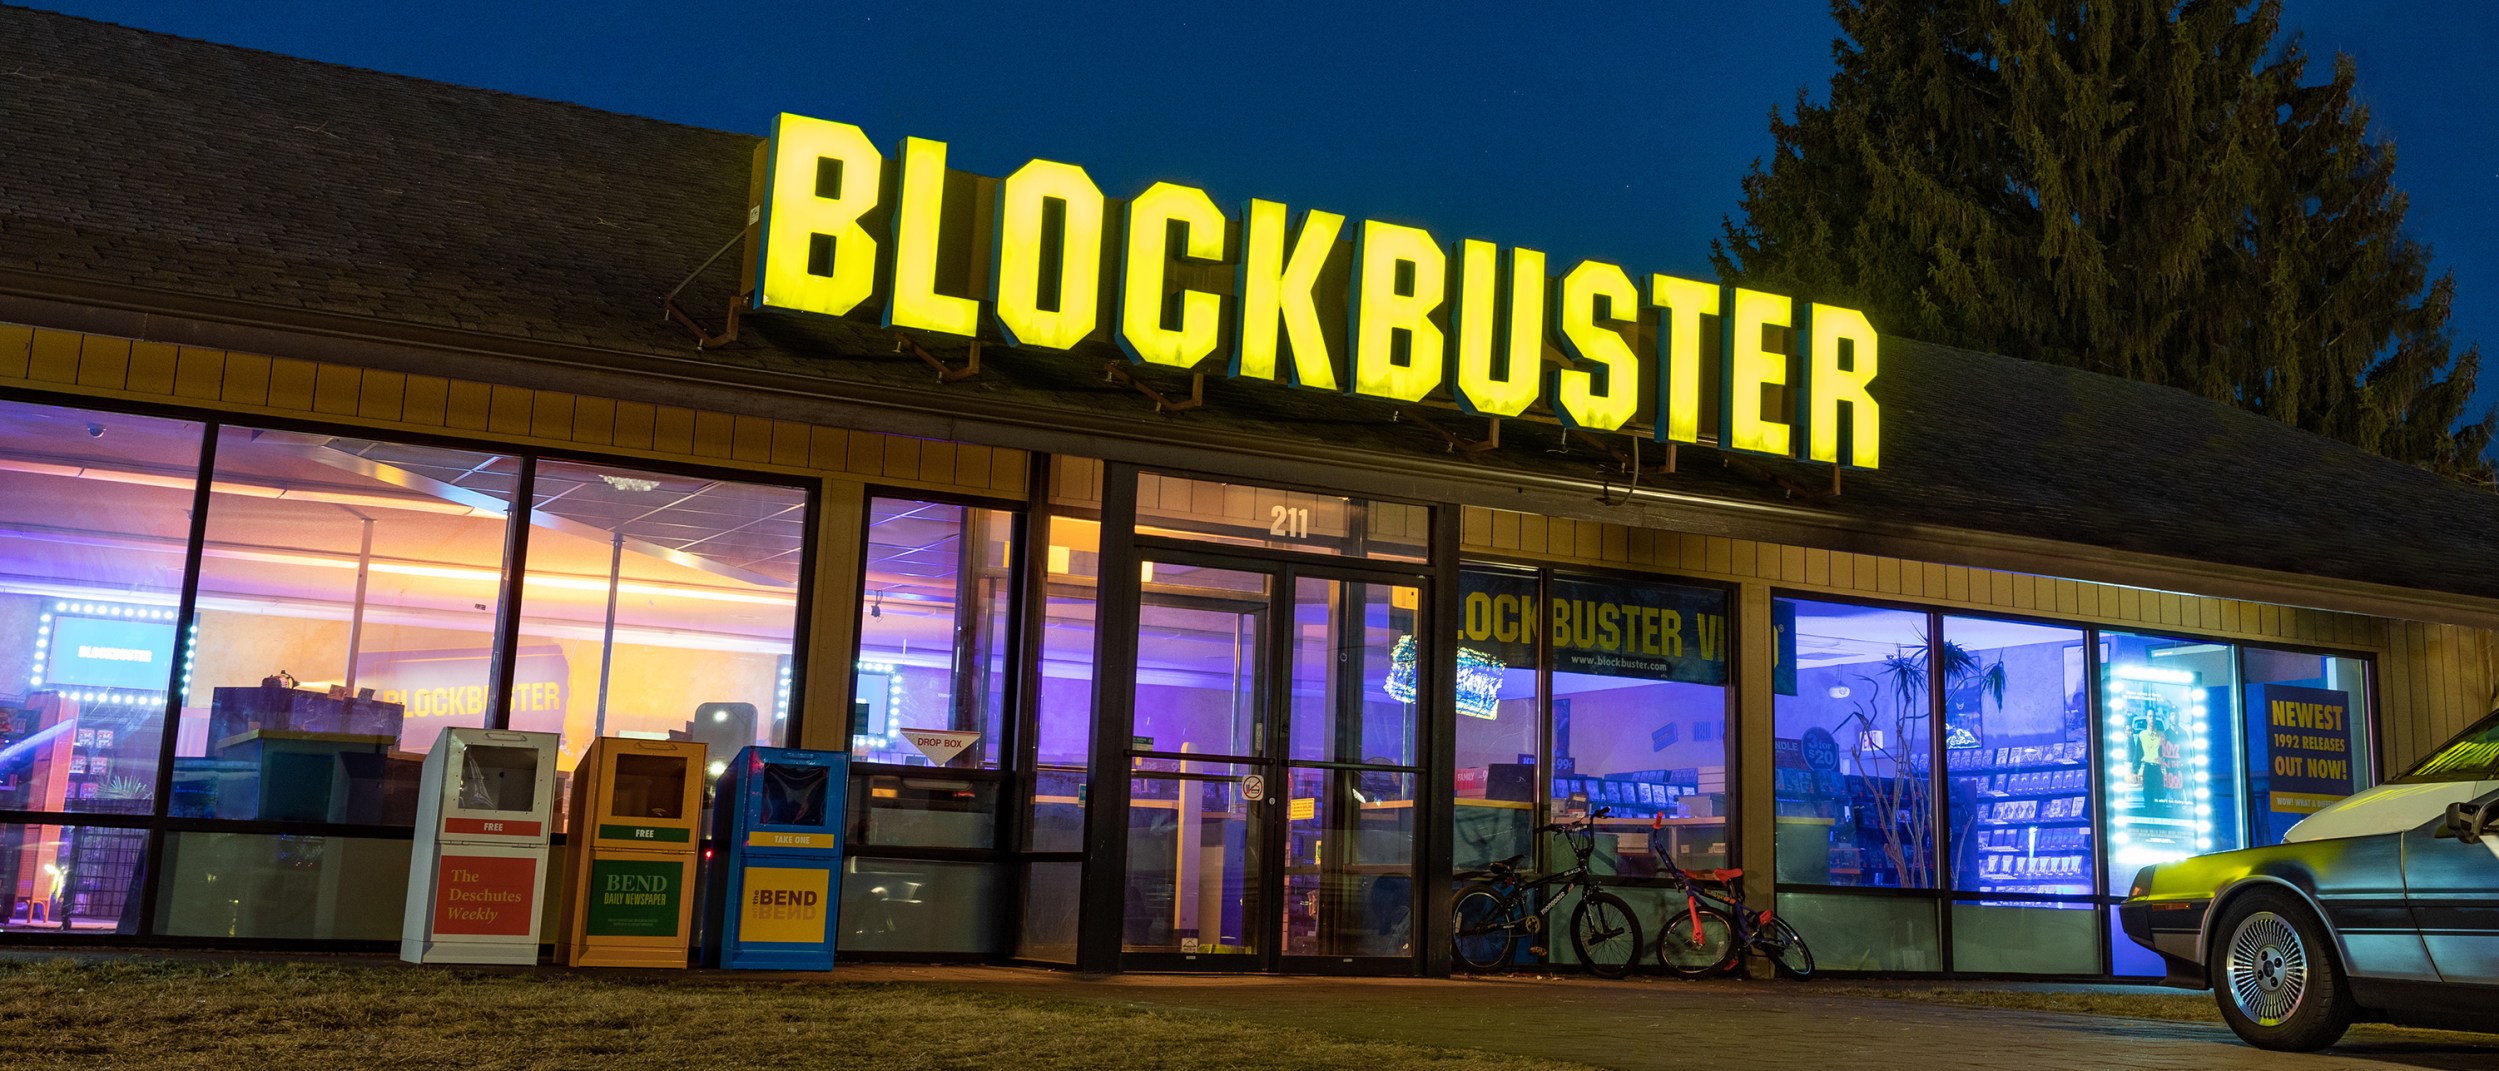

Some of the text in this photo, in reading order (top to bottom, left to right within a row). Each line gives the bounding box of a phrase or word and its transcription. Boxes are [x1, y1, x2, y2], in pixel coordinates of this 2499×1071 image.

[763, 112, 1880, 470] BLOCKBUSTER
[1270, 505, 1308, 539] 211
[1457, 591, 1682, 658] OCKBUSTER
[1571, 655, 1668, 672] www.blockbuster.com
[2271, 700, 2343, 731] NEWEST
[917, 737, 962, 748] DROP BOX
[1807, 733, 1818, 748] 3
[2274, 733, 2346, 752] 1992 RELEASES
[1808, 749, 1834, 765] $20
[2274, 755, 2348, 780] OUT NOW!
[483, 822, 504, 832] FREE
[635, 828, 655, 838] FREE
[774, 835, 811, 845] TAKE ONE
[451, 869, 480, 883] The
[606, 874, 668, 893] BEND
[448, 888, 523, 903] Deschutes
[604, 892, 667, 906] DAILY NEWSPAPER
[752, 889, 818, 907] the BEND
[447, 906, 499, 925] Weekly
